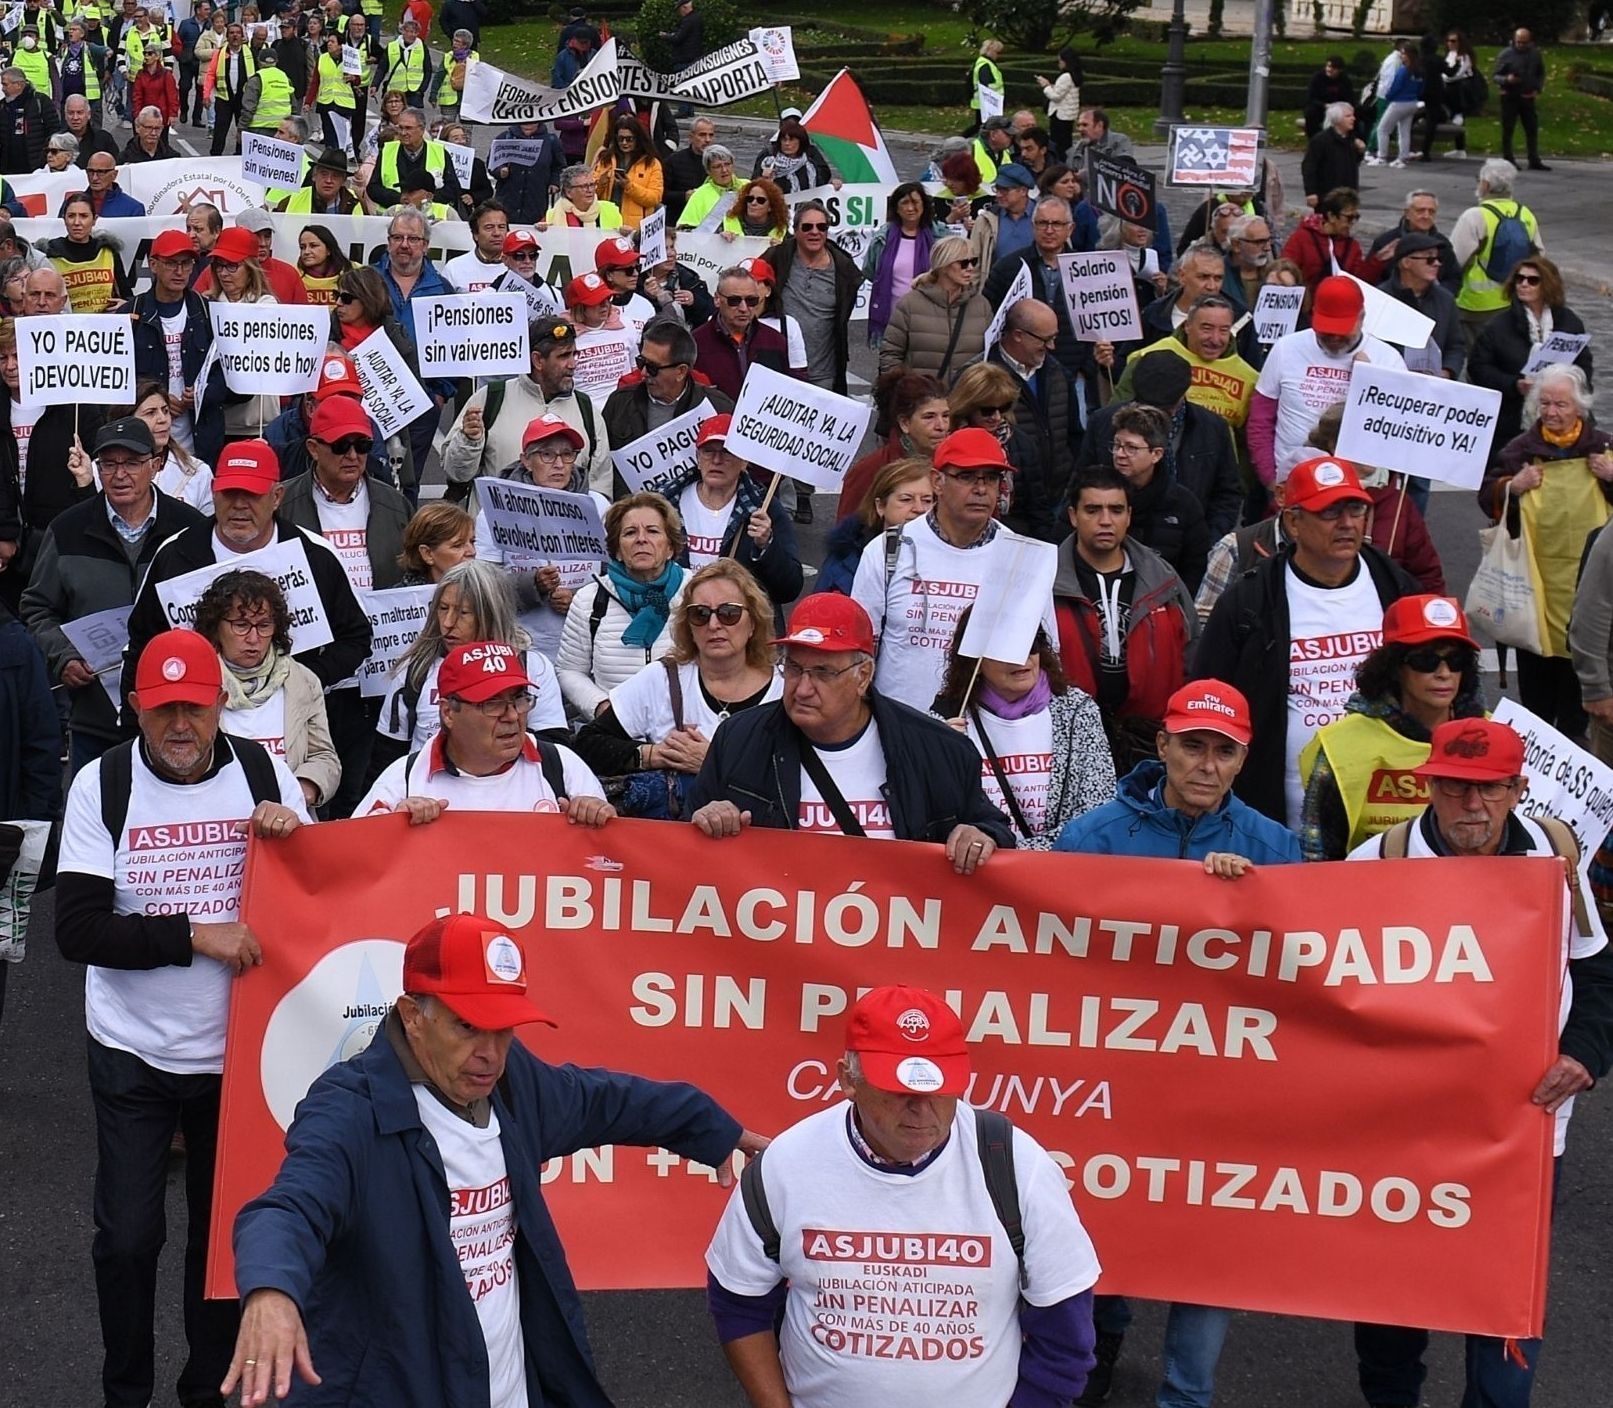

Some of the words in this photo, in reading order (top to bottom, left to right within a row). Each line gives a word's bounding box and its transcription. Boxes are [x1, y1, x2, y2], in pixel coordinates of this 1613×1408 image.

[248, 138, 296, 163] ¡Pensiones
[244, 159, 258, 174] sin
[183, 173, 212, 182] Estatal
[213, 176, 228, 185] por
[228, 181, 236, 189] la
[846, 196, 879, 228] SI,
[697, 257, 717, 270] por
[1068, 258, 1116, 284] ¡Salario
[1069, 292, 1077, 310] y
[1079, 284, 1128, 311] pensión
[217, 315, 239, 338] Las
[243, 317, 318, 344] pensiones,
[428, 302, 513, 333] ¡Pensiones
[1078, 308, 1132, 334] JUSTOS!
[31, 331, 56, 355] YO
[65, 327, 129, 356] PAGUÉ.
[425, 341, 445, 363] sin
[450, 335, 523, 362] vaivenes!
[274, 351, 291, 374] de
[295, 352, 318, 378] hoy.
[362, 349, 398, 391] ¡AUDITAR,
[1308, 366, 1350, 380] ASJUB
[30, 364, 129, 395] ¡DEVOLVED!
[1299, 383, 1314, 391] SIN
[389, 385, 406, 405] YA,
[397, 399, 416, 416] LA
[1358, 385, 1445, 418] ¡Recuperar
[1444, 407, 1493, 429] poder
[368, 397, 400, 433] SOCIAL!
[757, 394, 819, 433] ¡AUDITAR,
[819, 413, 837, 441] YA,
[836, 421, 857, 443] LA
[736, 414, 804, 457] SEGURIDAD
[801, 441, 851, 473] SOCIAL!
[1363, 416, 1446, 446] adquisitivo
[1450, 431, 1478, 453] YA!
[627, 450, 653, 474] YO
[488, 485, 505, 512] Mi
[504, 488, 540, 517] ahorro
[539, 493, 589, 525] forzoso,
[492, 520, 540, 552] devolved
[540, 533, 562, 554] con
[561, 528, 607, 556] interés.
[915, 580, 977, 599] ASJUB
[382, 605, 427, 625] maltratan
[462, 644, 514, 665] ASJUBI
[482, 656, 507, 673] 40
[364, 659, 386, 679] para
[1187, 699, 1236, 718] Emirates
[1203, 693, 1221, 703] Fly
[1555, 755, 1572, 787] de
[1568, 765, 1594, 799] SS
[134, 821, 249, 849] ASJUBI4
[126, 851, 196, 865] JUBILACIÓN
[126, 870, 158, 885] SIN
[135, 887, 162, 896] CON
[165, 884, 191, 896] MÁS
[193, 885, 210, 894] DE
[211, 882, 225, 892] 40
[434, 872, 942, 949] JUBILACIÓN
[970, 904, 1495, 987] ANTICIPADA
[629, 971, 767, 1030] SIN
[802, 983, 1279, 1062] PALIZAR
[808, 1234, 984, 1264] ASJUBI40
[863, 1265, 927, 1279] EUSKADI
[817, 1278, 898, 1293] JUBILACIÓN
[902, 1282, 975, 1296] ATICIPADA
[814, 1291, 845, 1310] SIN
[854, 1295, 978, 1318] PENALIZAR
[816, 1312, 846, 1327] CON
[851, 1316, 884, 1332] MÁS
[889, 1320, 908, 1333] DE
[913, 1321, 931, 1334] 40
[935, 1320, 976, 1335] AÑOS
[811, 1323, 985, 1361] COTIZADOS
